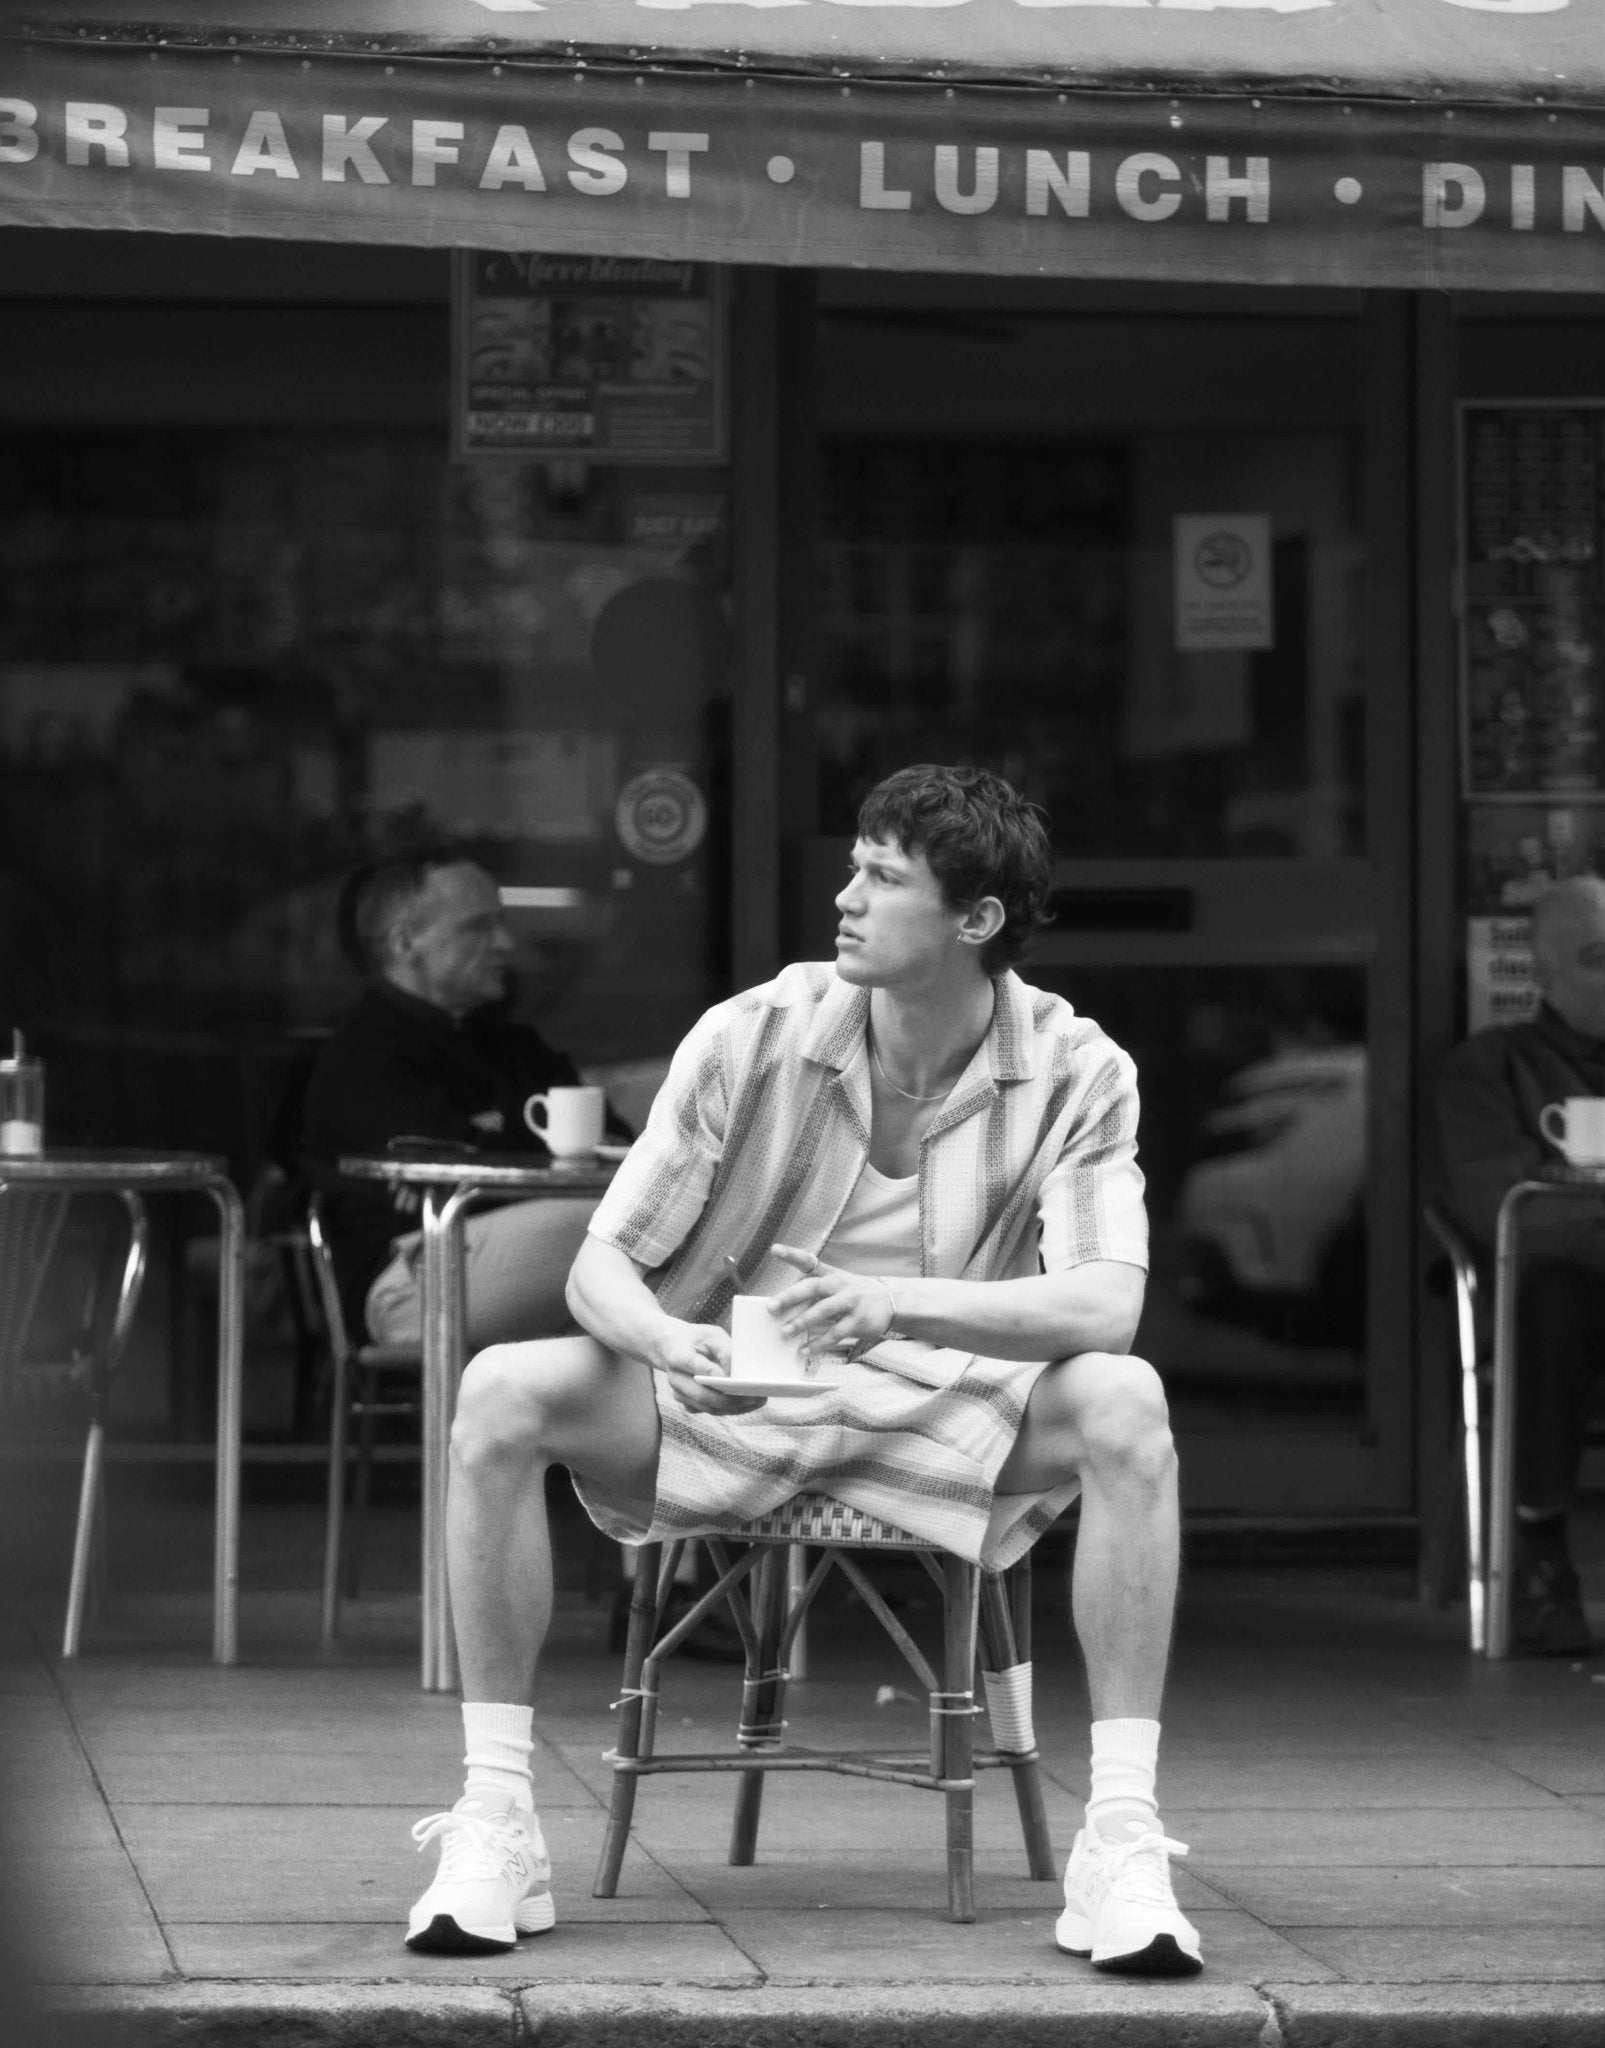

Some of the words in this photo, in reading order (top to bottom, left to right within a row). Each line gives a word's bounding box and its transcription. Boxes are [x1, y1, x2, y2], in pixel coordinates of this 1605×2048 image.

[0, 98, 709, 198] BREAKFAST
[860, 141, 1270, 222] LUNCH
[1424, 163, 1605, 231] DIN
